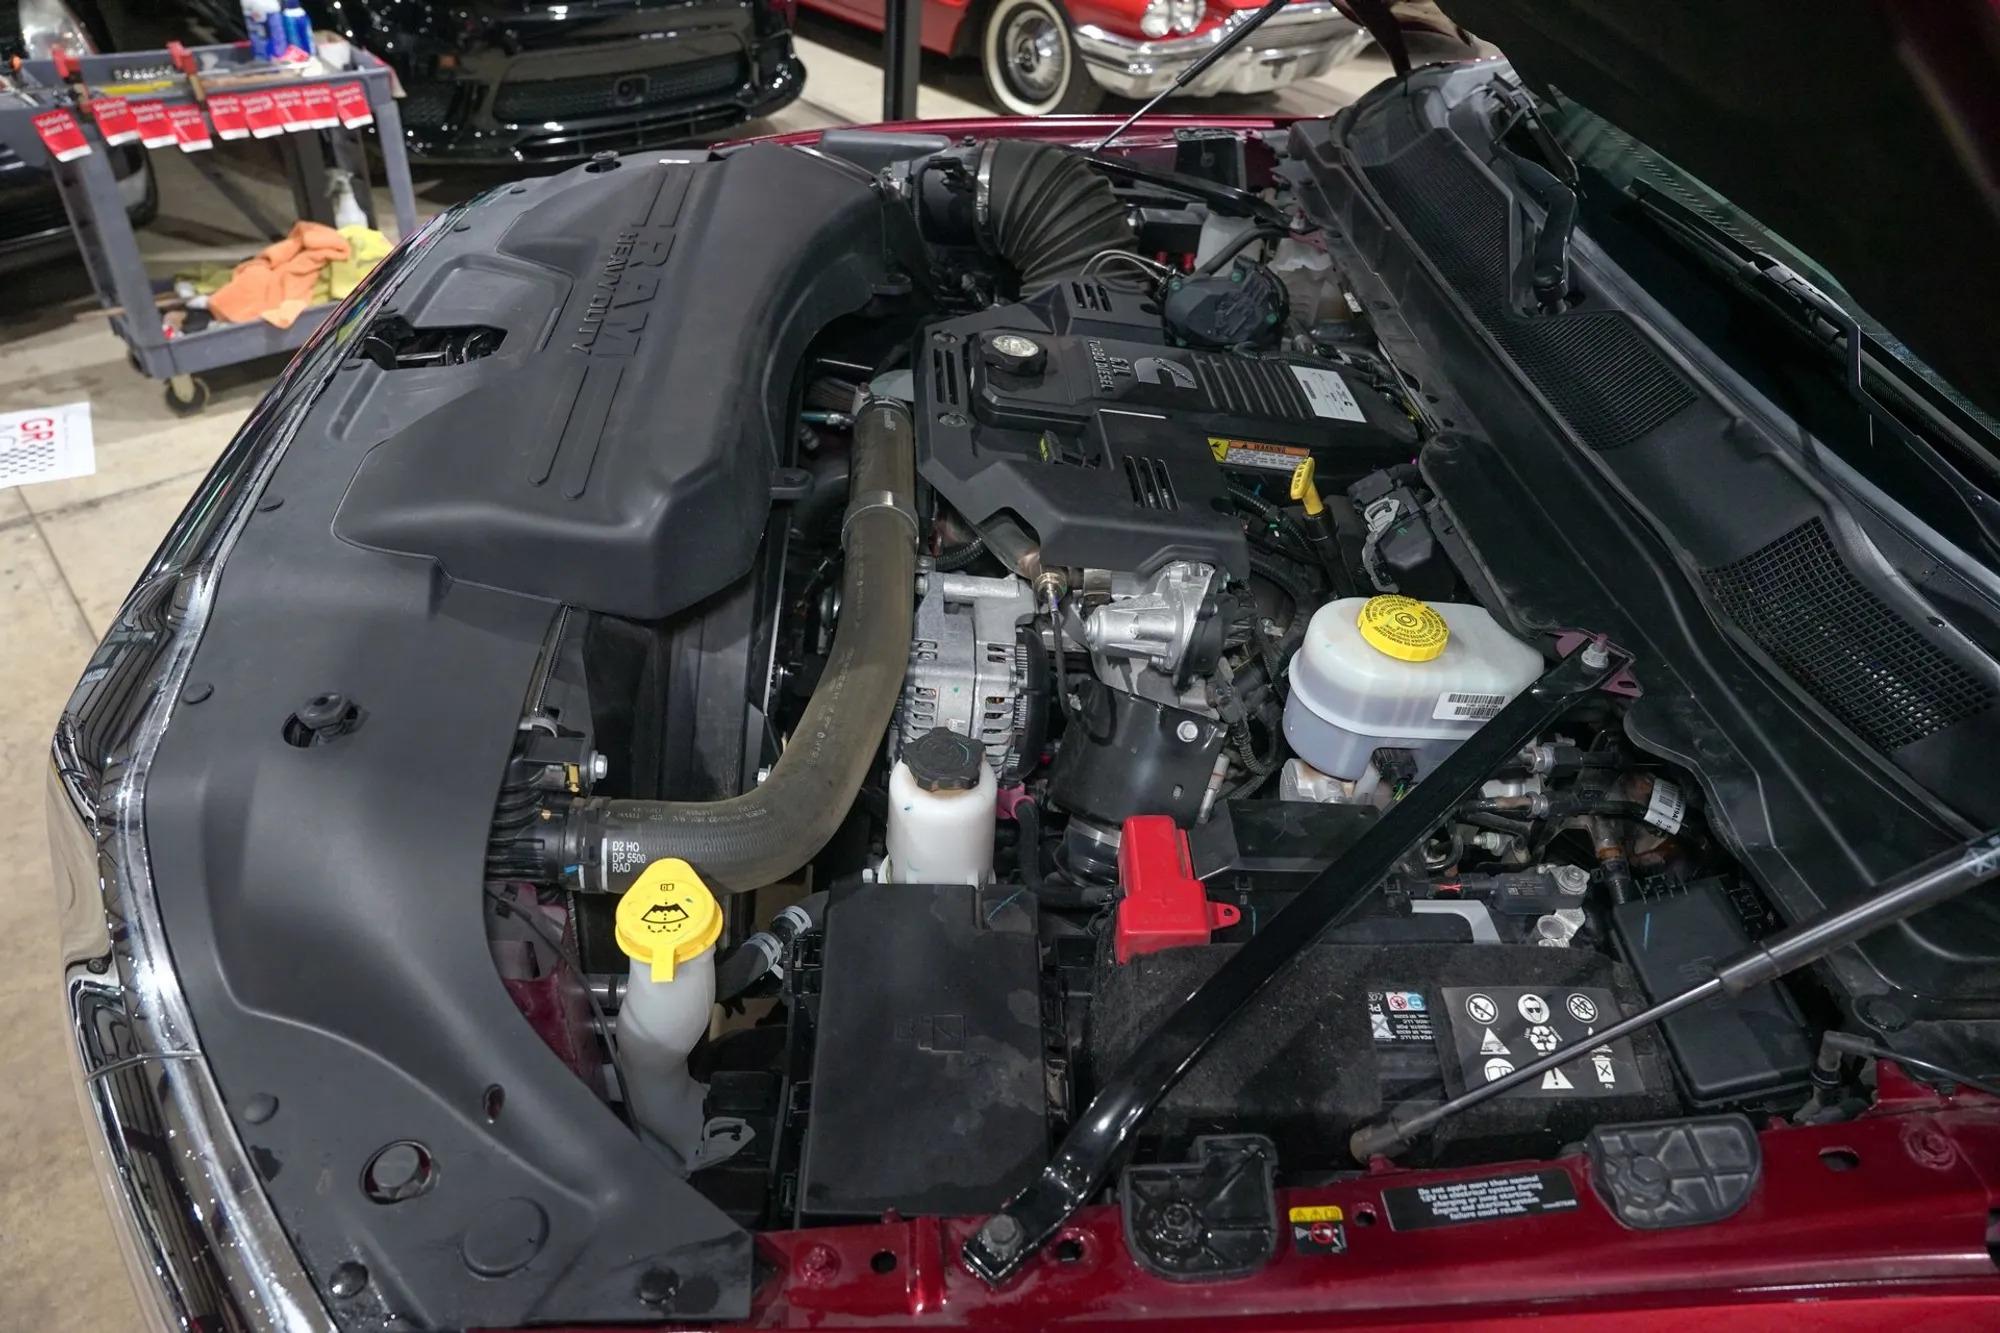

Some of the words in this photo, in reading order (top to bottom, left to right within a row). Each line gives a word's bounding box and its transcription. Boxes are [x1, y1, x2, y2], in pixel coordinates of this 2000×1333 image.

[597, 231, 640, 293] HEAVY
[594, 232, 677, 357] RAM
[572, 294, 614, 355] DUTY
[612, 841, 624, 852] D2
[626, 842, 640, 852] HO
[612, 853, 625, 863] DP
[626, 853, 646, 864] 5500
[612, 863, 631, 873] RAD
[1446, 1184, 1468, 1193] apply
[1468, 1182, 1489, 1190] more
[1449, 1188, 1487, 1199] electrical
[1488, 1185, 1516, 1195] system
[1517, 1182, 1543, 1191] during
[1432, 1198, 1468, 1208] charging
[1432, 1207, 1459, 1216] Engine
[1460, 1203, 1476, 1212] and
[1476, 1200, 1510, 1210] starting
[1510, 1197, 1540, 1207] system
[1449, 1211, 1476, 1220] failure
[1477, 1207, 1499, 1217] could
